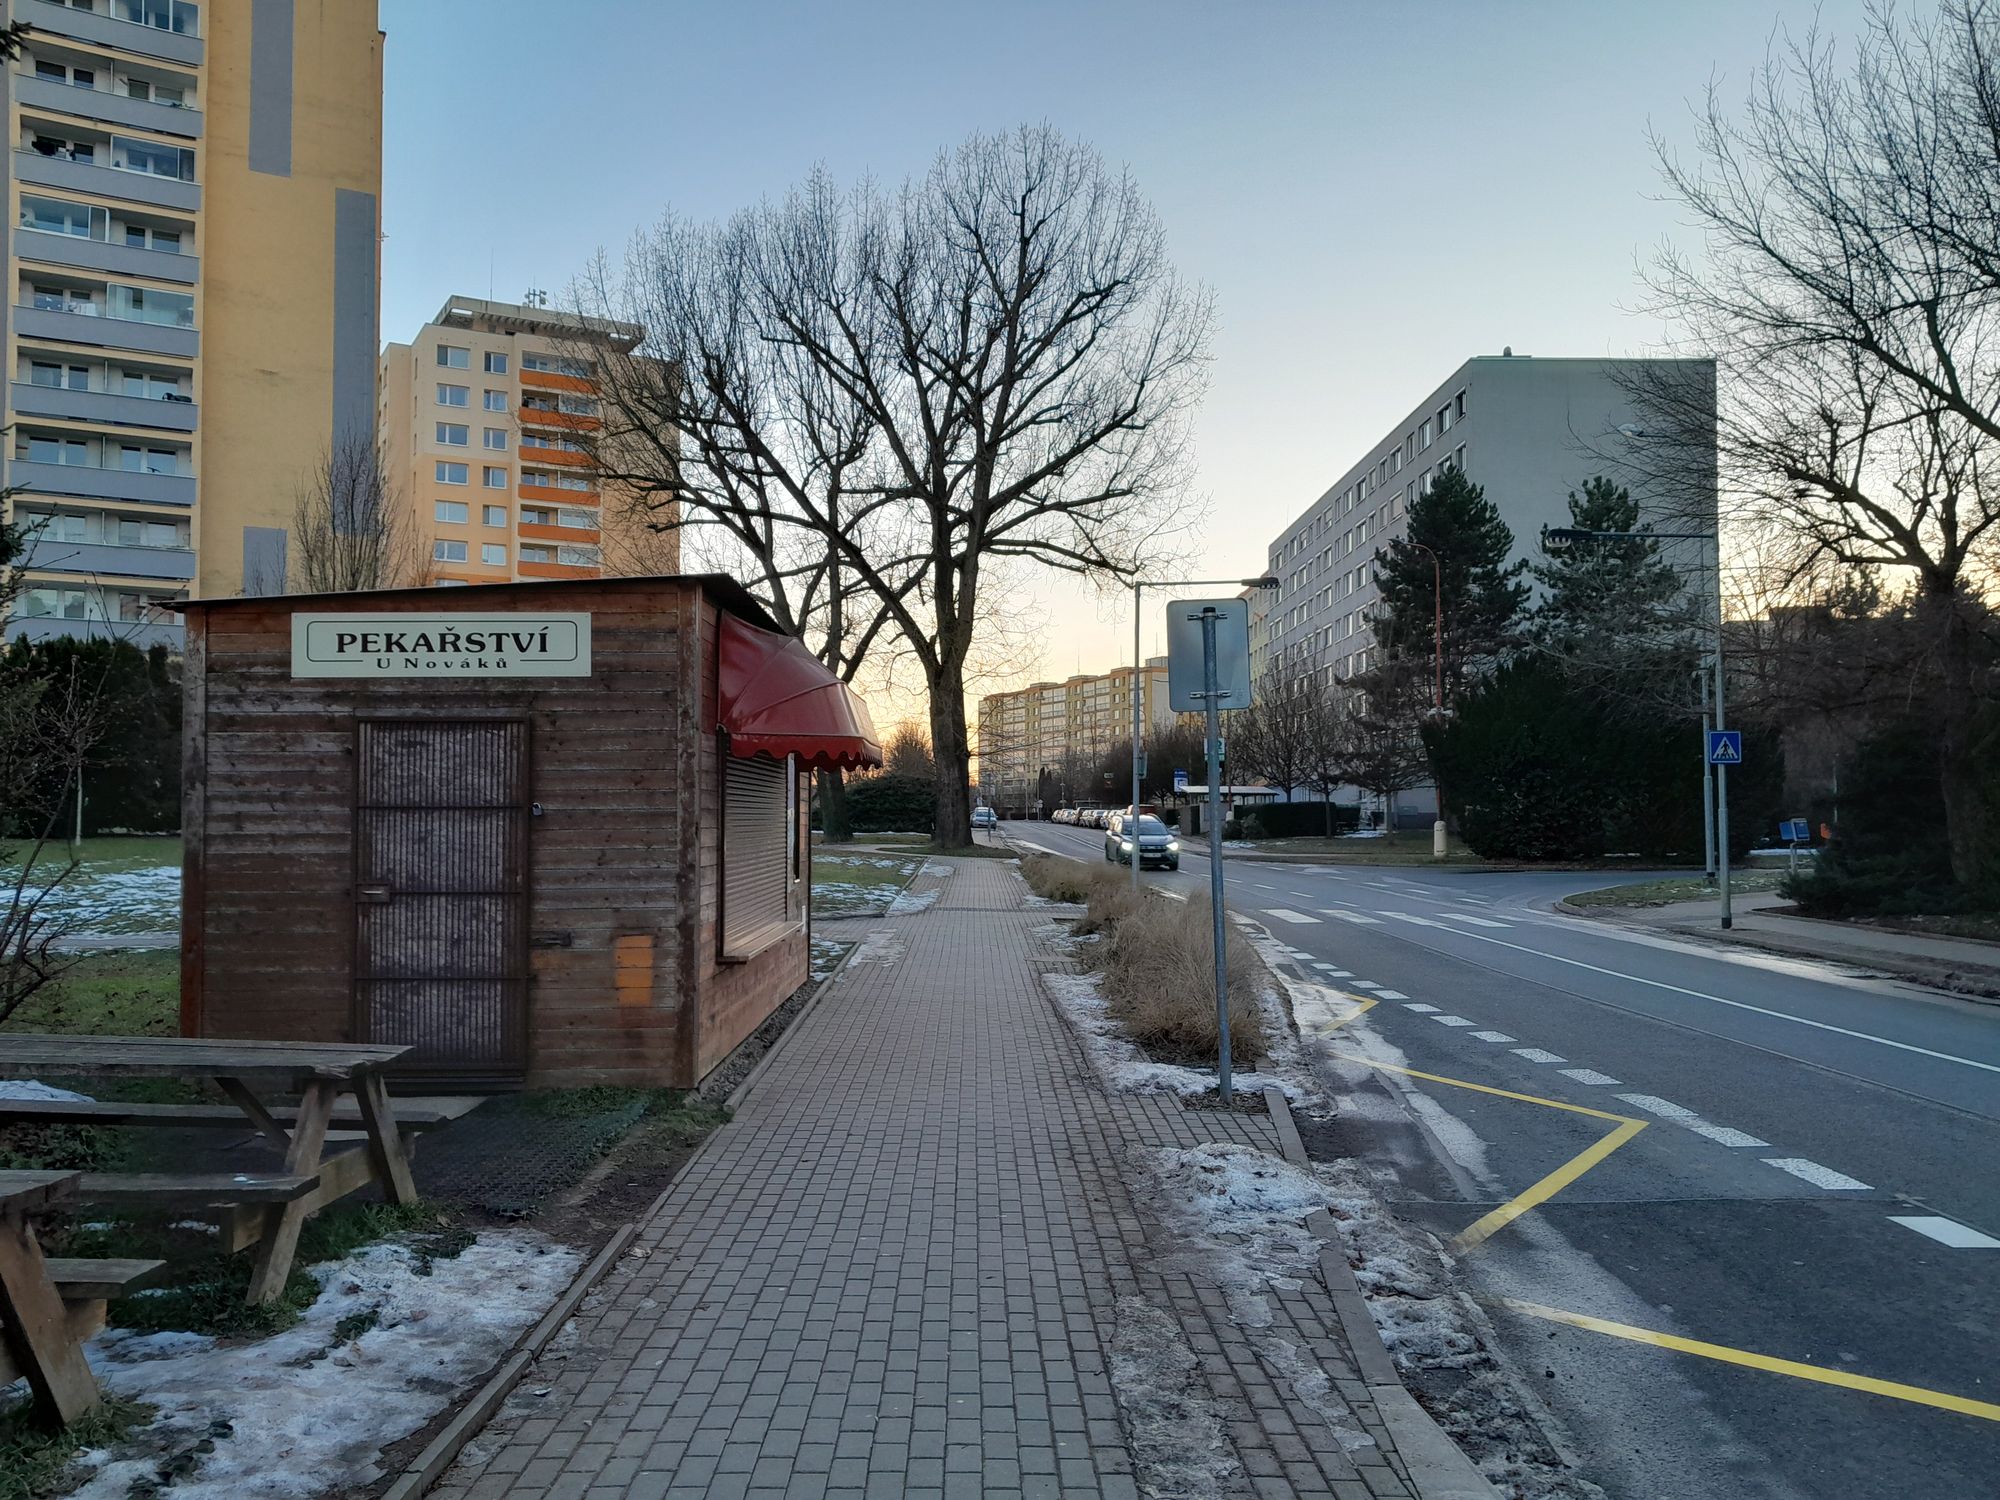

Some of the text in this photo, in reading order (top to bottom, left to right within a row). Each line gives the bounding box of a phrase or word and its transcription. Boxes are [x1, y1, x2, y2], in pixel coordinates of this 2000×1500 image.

[336, 626, 549, 653] PEKAŘSTVÍ
[376, 657, 508, 669] U Nováků
